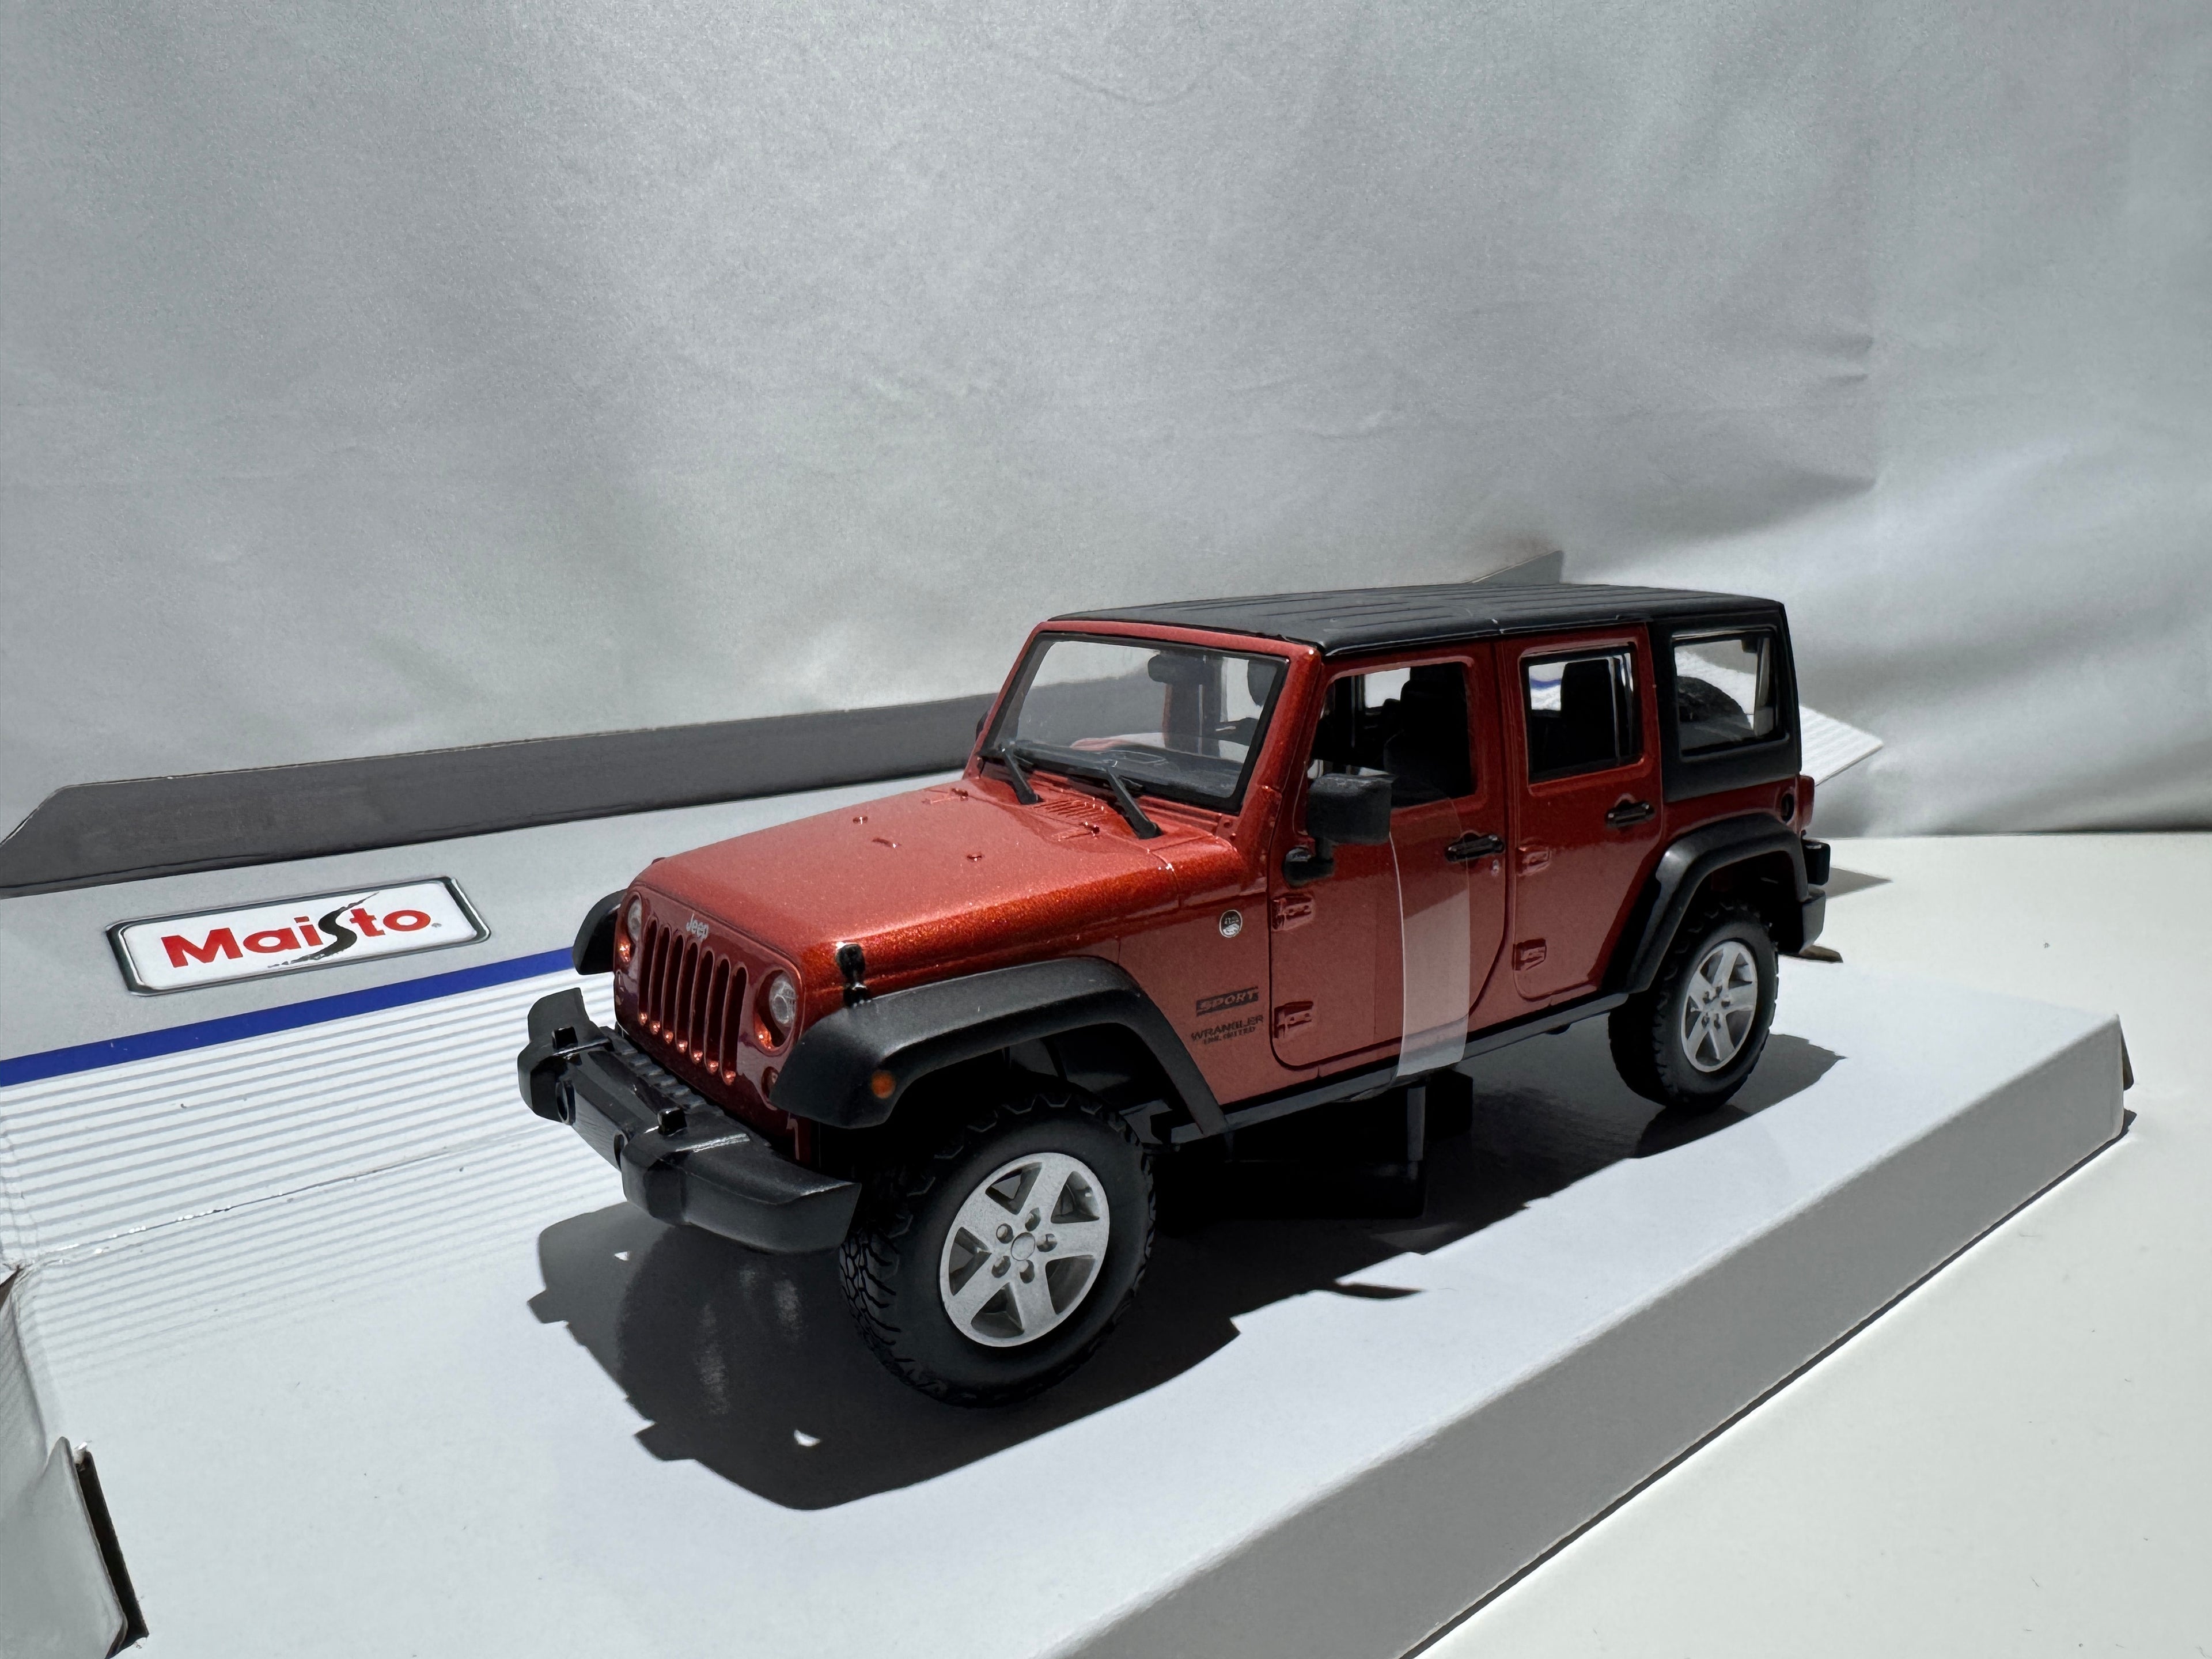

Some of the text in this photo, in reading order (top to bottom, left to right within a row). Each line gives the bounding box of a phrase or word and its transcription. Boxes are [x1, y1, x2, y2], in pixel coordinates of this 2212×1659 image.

[686, 912, 709, 940] Jeep
[1198, 990, 1258, 1012] SPORT
[1191, 1014, 1264, 1041] WRANGLER
